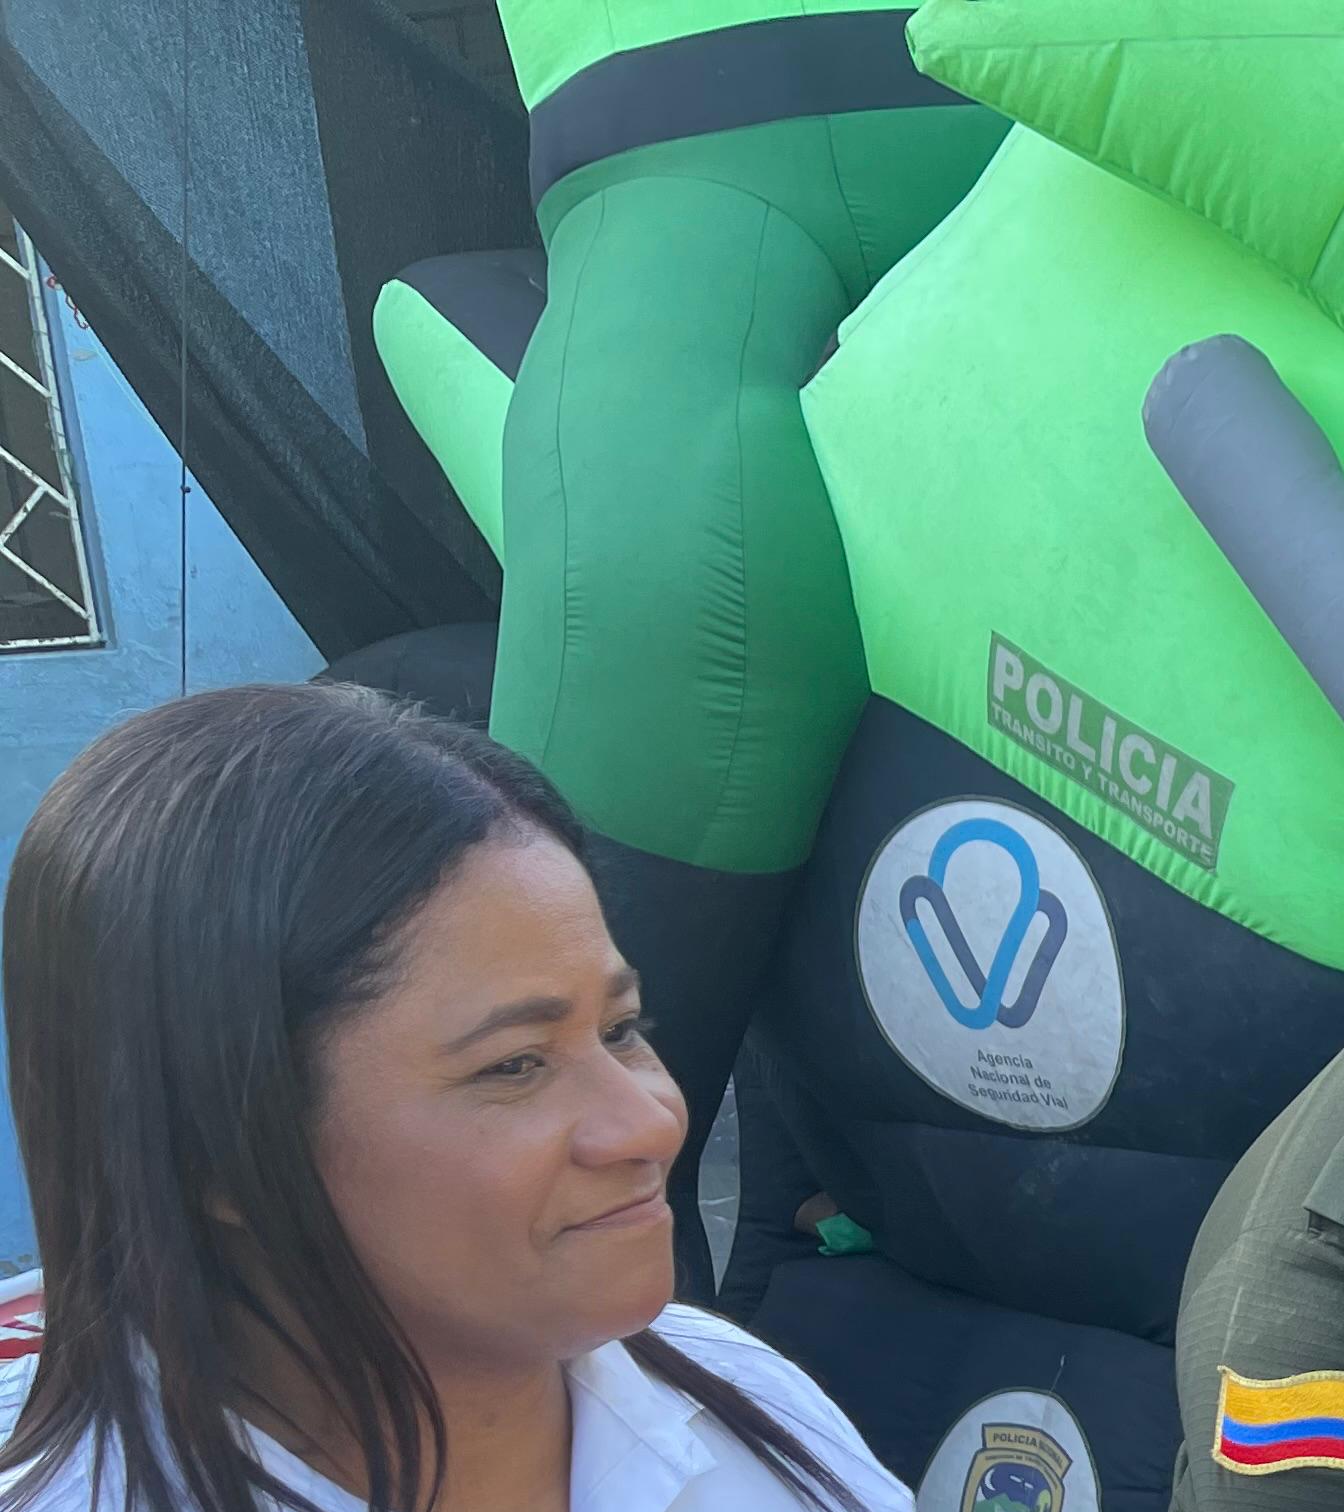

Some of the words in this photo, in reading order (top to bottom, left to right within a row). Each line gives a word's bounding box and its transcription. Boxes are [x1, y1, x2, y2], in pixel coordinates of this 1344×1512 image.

[993, 644, 1213, 839] POLICIA
[991, 701, 1075, 769] TRANSITO
[1080, 762, 1093, 780] Y
[1097, 772, 1214, 864] TRANSPORTE
[977, 1049, 1033, 1069] Agencia
[970, 1065, 1031, 1087] Nacional
[1034, 1075, 1052, 1090] de
[968, 1083, 1039, 1104] Seguridad
[1040, 1092, 1069, 1110] Vial
[993, 1432, 1038, 1448] POLICIA
